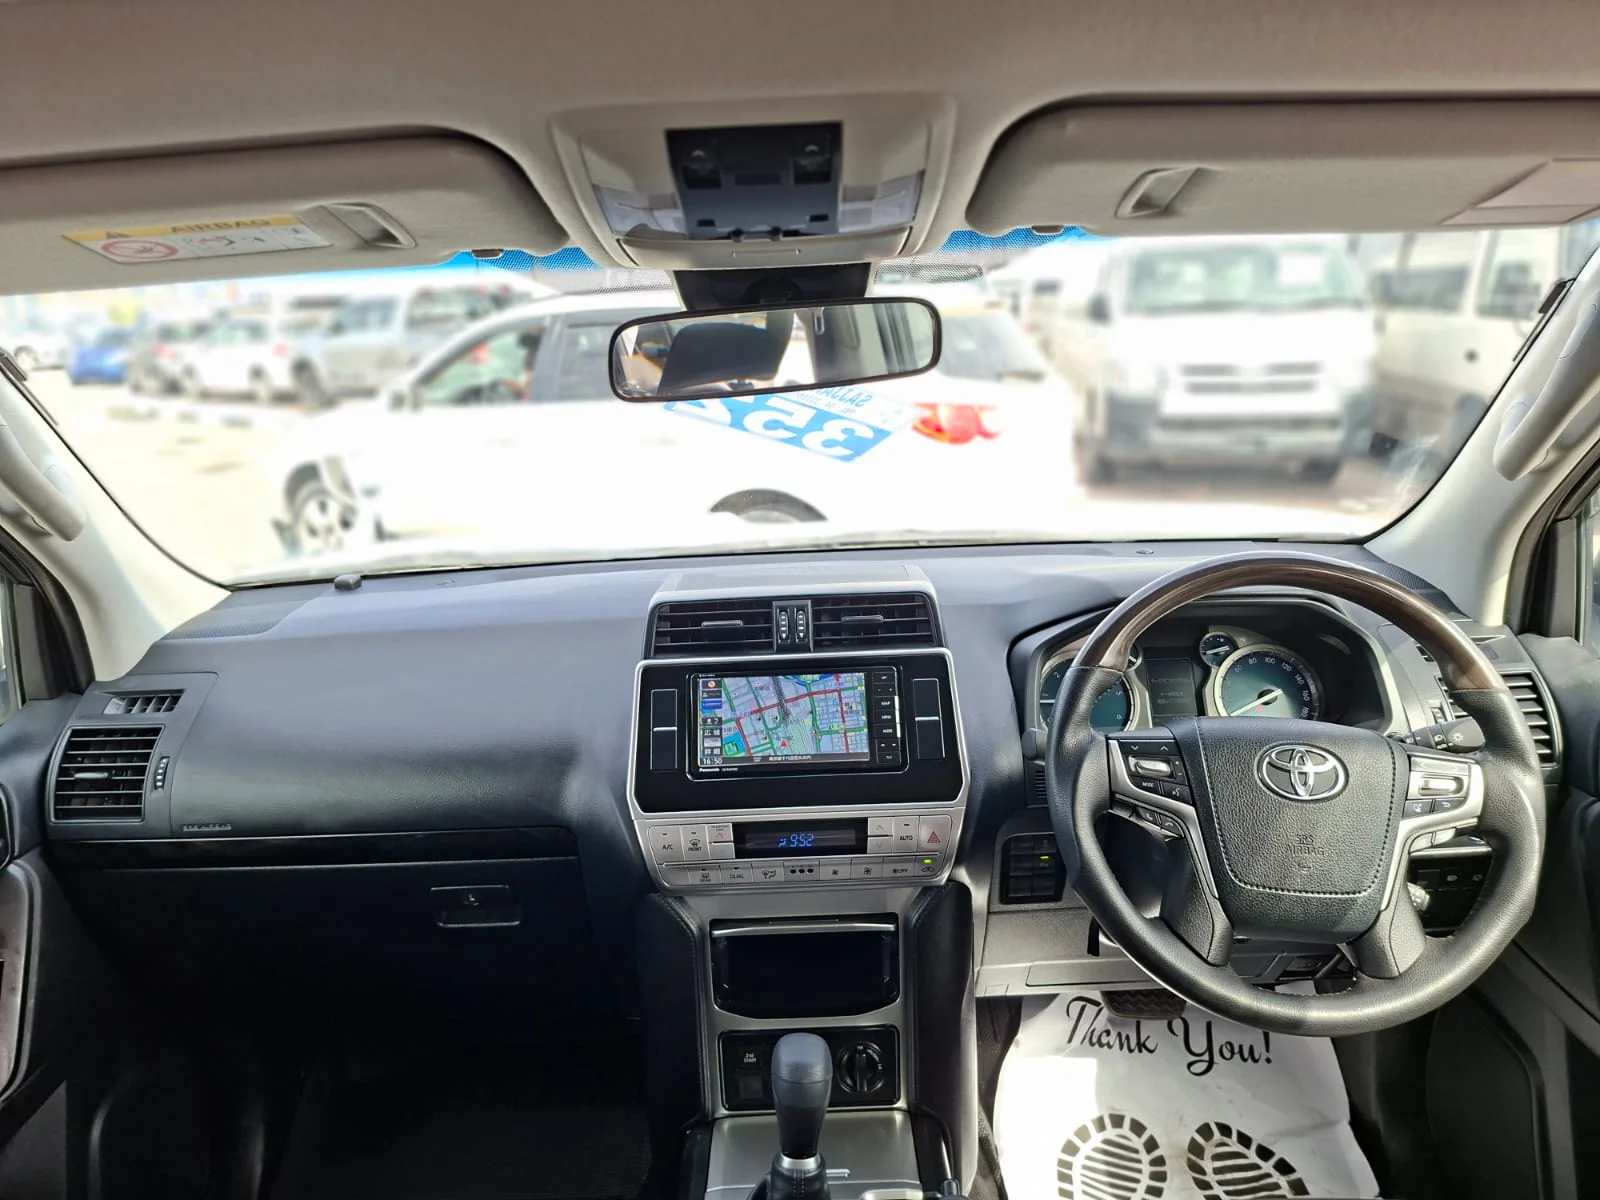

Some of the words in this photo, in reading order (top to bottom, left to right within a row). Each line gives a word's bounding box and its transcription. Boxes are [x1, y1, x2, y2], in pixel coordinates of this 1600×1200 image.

[171, 219, 271, 233] AIRBAG
[1248, 657, 1257, 665] 80
[1264, 657, 1276, 665] 100
[1281, 662, 1293, 672] 120
[1053, 671, 1061, 679] 2
[1294, 674, 1305, 686] 140
[1302, 690, 1310, 702] 160
[1301, 707, 1309, 718] 180
[1287, 846, 1325, 856] AIRBAG
[1066, 995, 1158, 1054] Thank
[1166, 1016, 1273, 1077] You!
